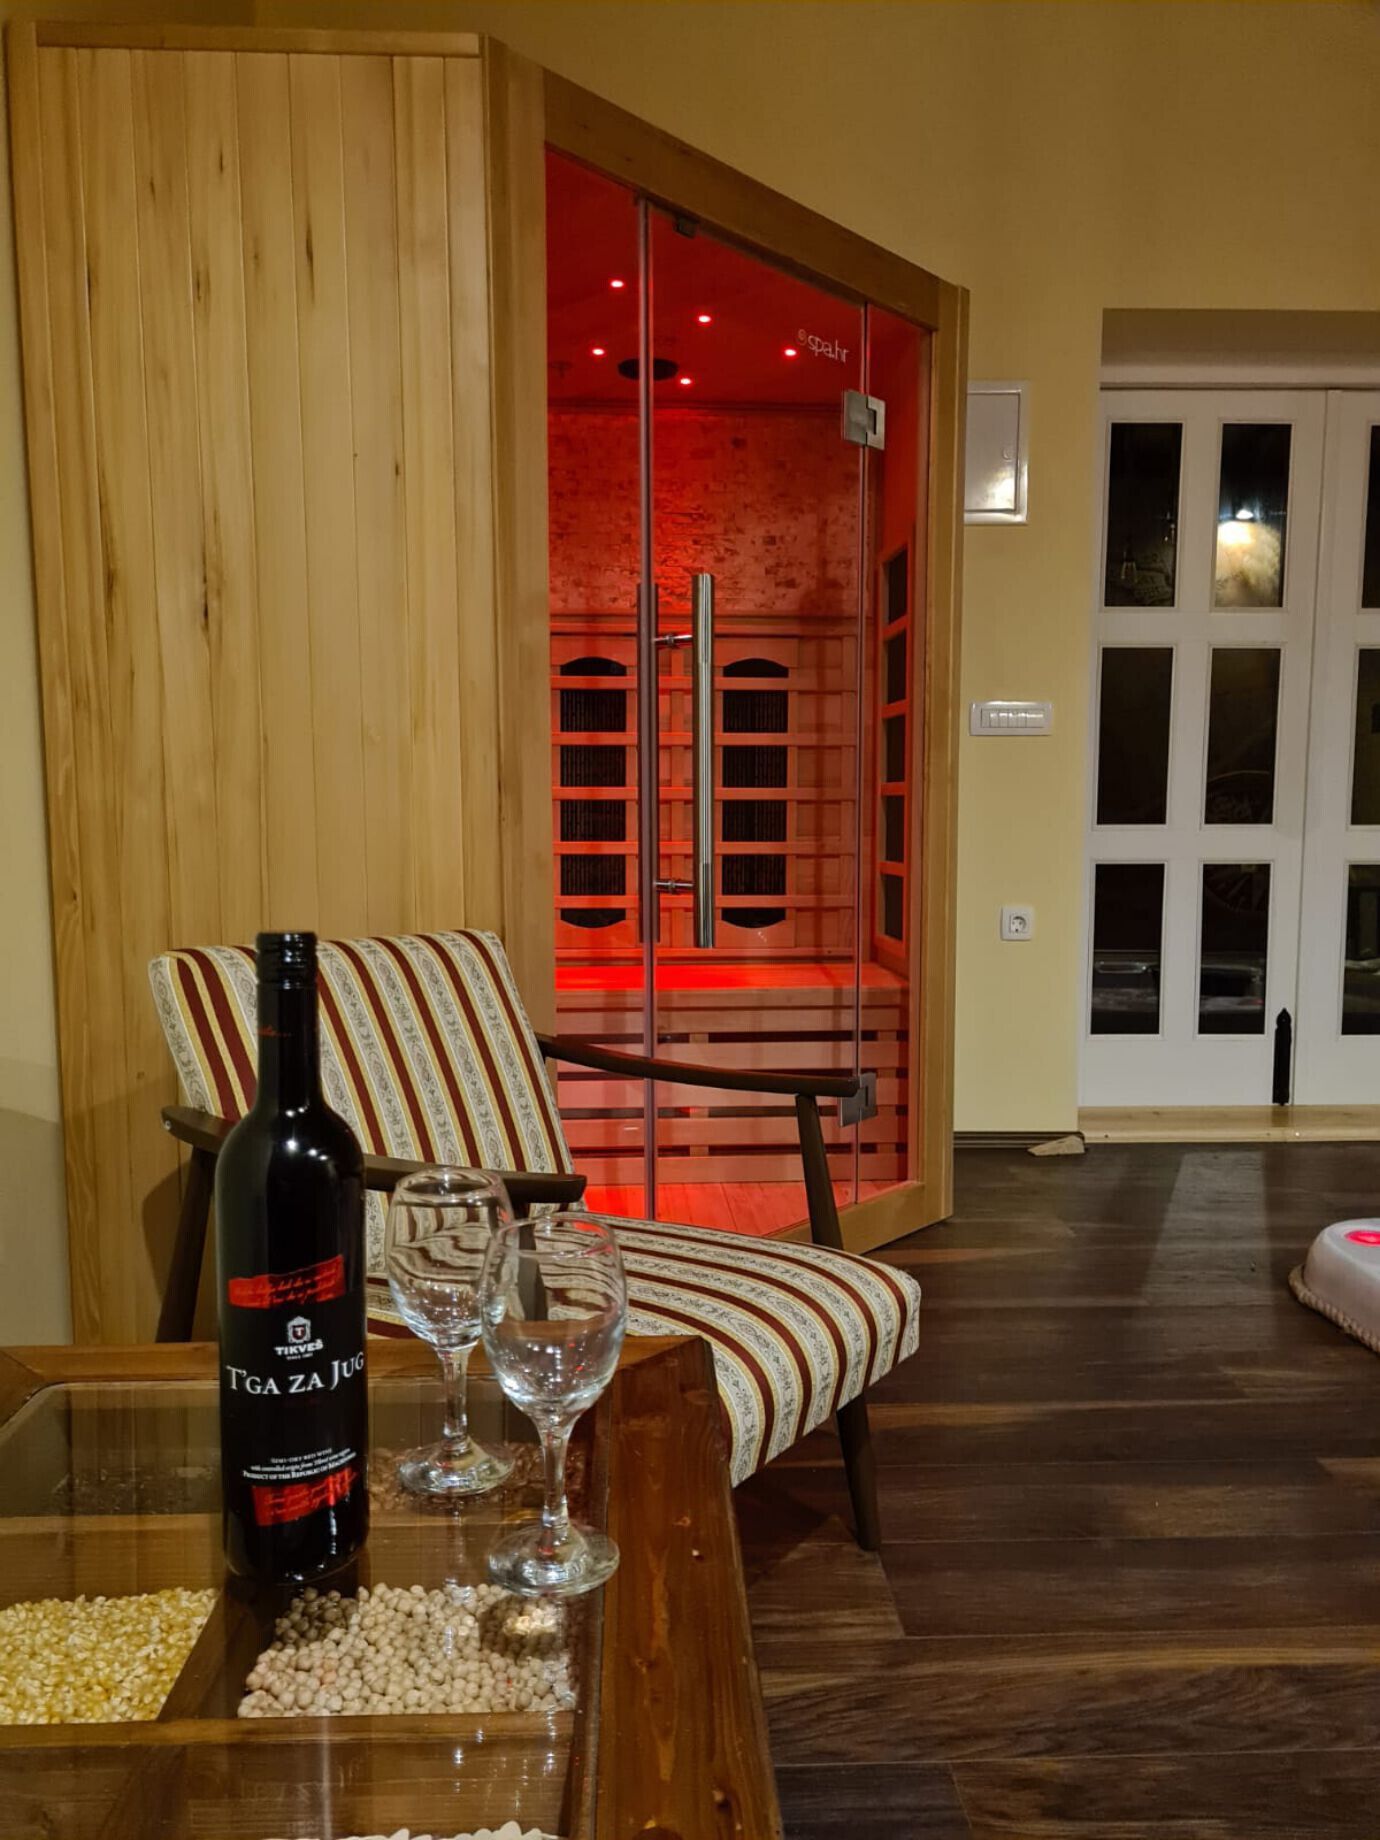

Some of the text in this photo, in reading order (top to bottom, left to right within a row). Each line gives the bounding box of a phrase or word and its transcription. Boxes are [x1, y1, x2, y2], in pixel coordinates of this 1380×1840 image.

[274, 1338, 324, 1356] TIKVEŠ
[288, 1371, 325, 1394] ZA
[330, 1351, 365, 1390] JUG
